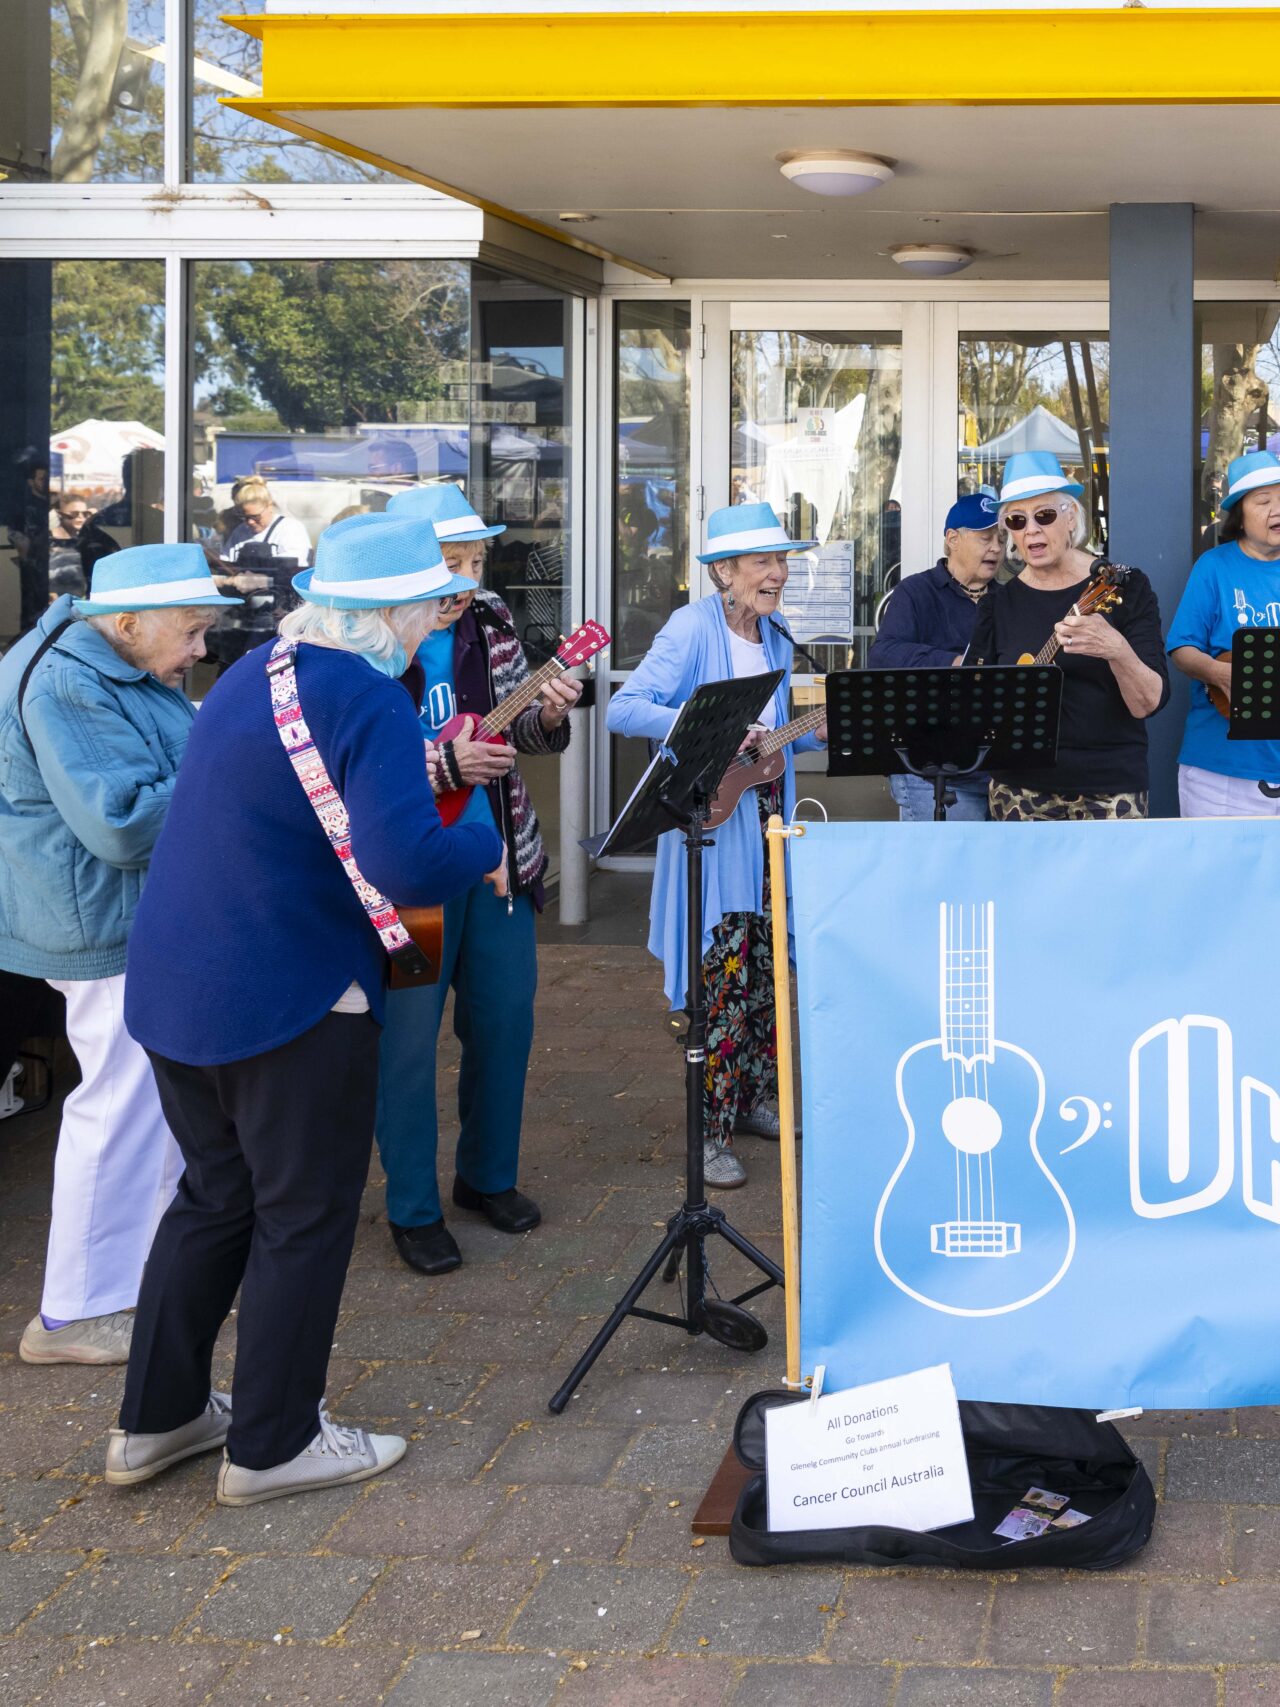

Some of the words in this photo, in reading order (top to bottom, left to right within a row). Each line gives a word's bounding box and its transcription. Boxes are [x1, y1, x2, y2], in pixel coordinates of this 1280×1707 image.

[827, 1417, 841, 1431] All
[844, 1403, 899, 1427] Donations
[790, 1461, 818, 1471] Glenelg
[818, 1451, 859, 1466] Community
[859, 1445, 878, 1457] Clubs
[879, 1439, 902, 1452] annual
[902, 1430, 941, 1446] fundraising
[845, 1436, 856, 1445] Go
[857, 1429, 885, 1442] Towards
[862, 1464, 874, 1472] For
[793, 1491, 838, 1508] Cancer
[841, 1478, 887, 1499] Council
[890, 1465, 945, 1489] Australia
